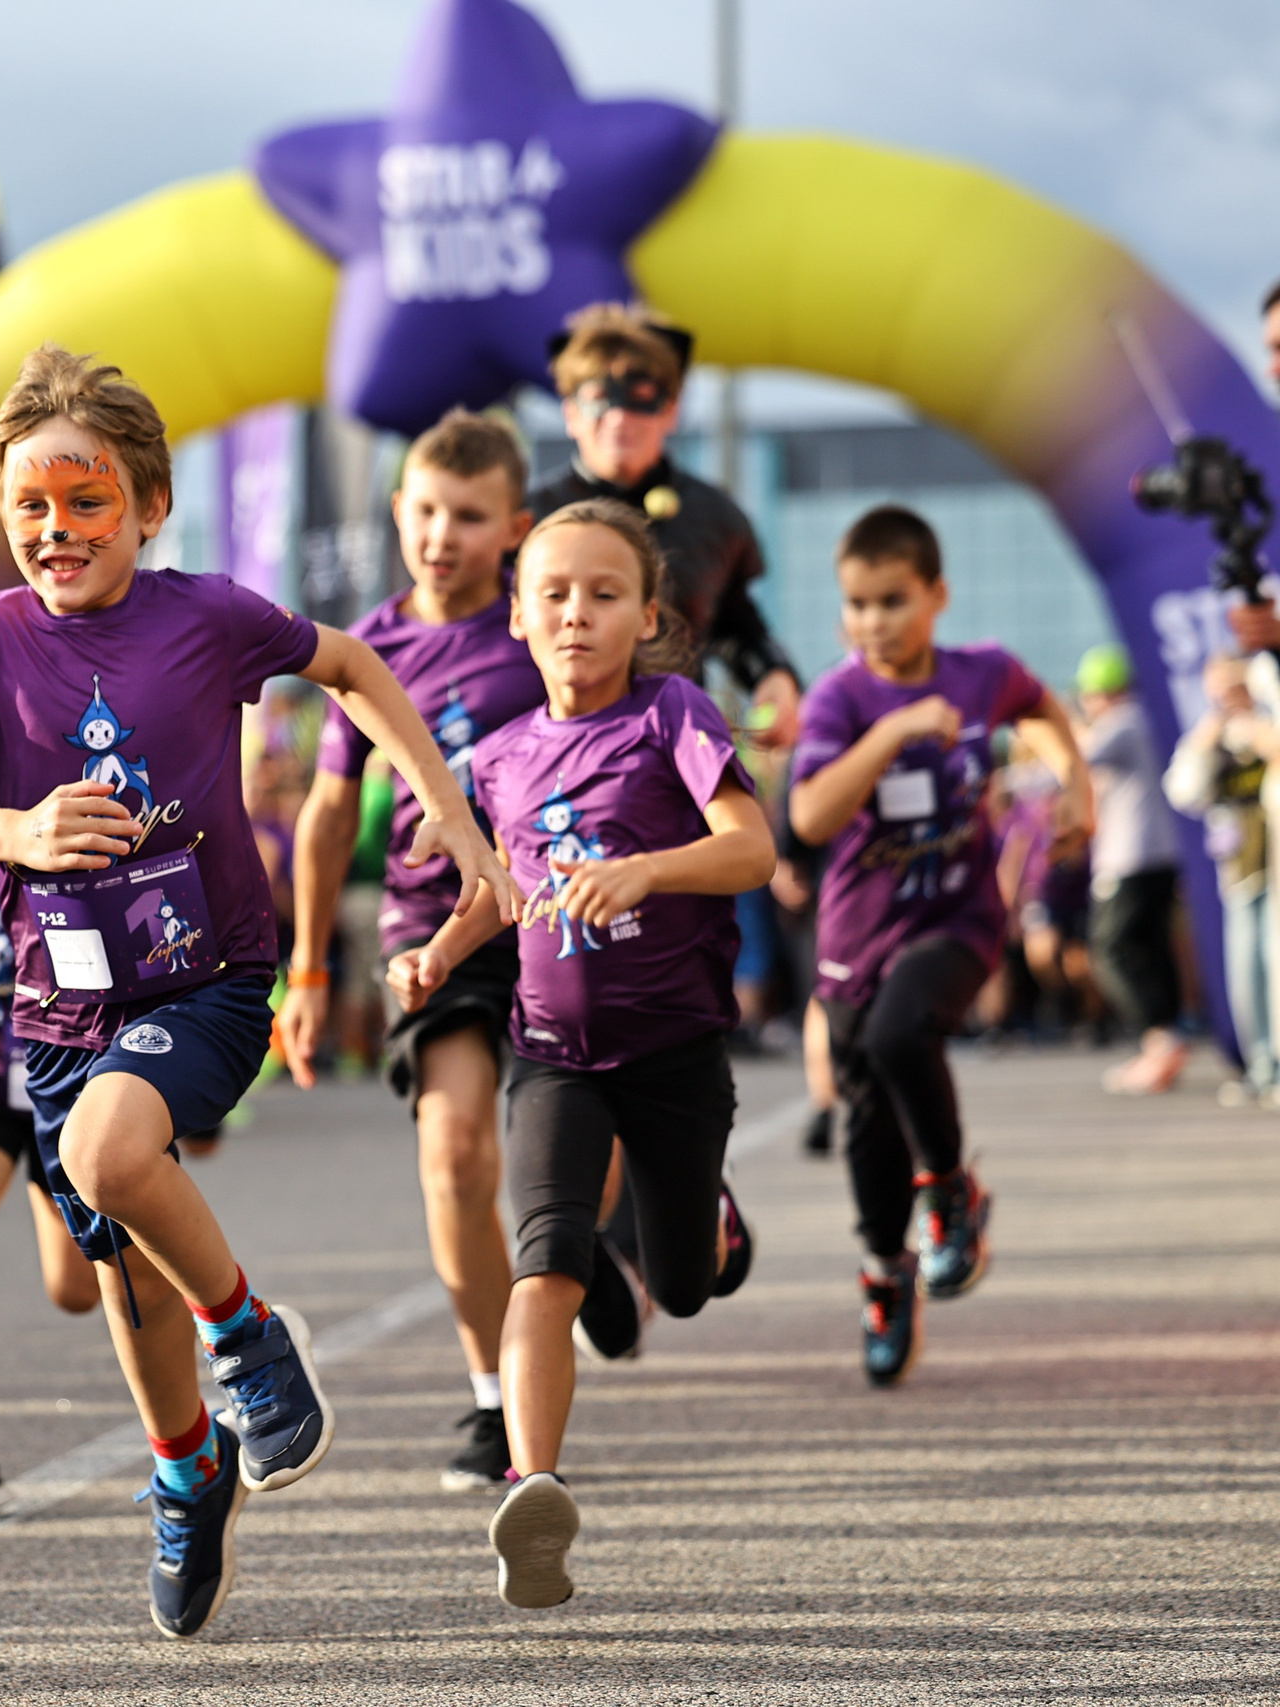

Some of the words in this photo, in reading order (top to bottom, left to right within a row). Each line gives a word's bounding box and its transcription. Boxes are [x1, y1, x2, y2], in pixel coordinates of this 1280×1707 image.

[384, 206, 552, 302] KIDS
[145, 857, 188, 875] SUPREME
[37, 912, 67, 926] 7-12
[609, 921, 643, 942] KIDS
[146, 927, 203, 966] Сириус
